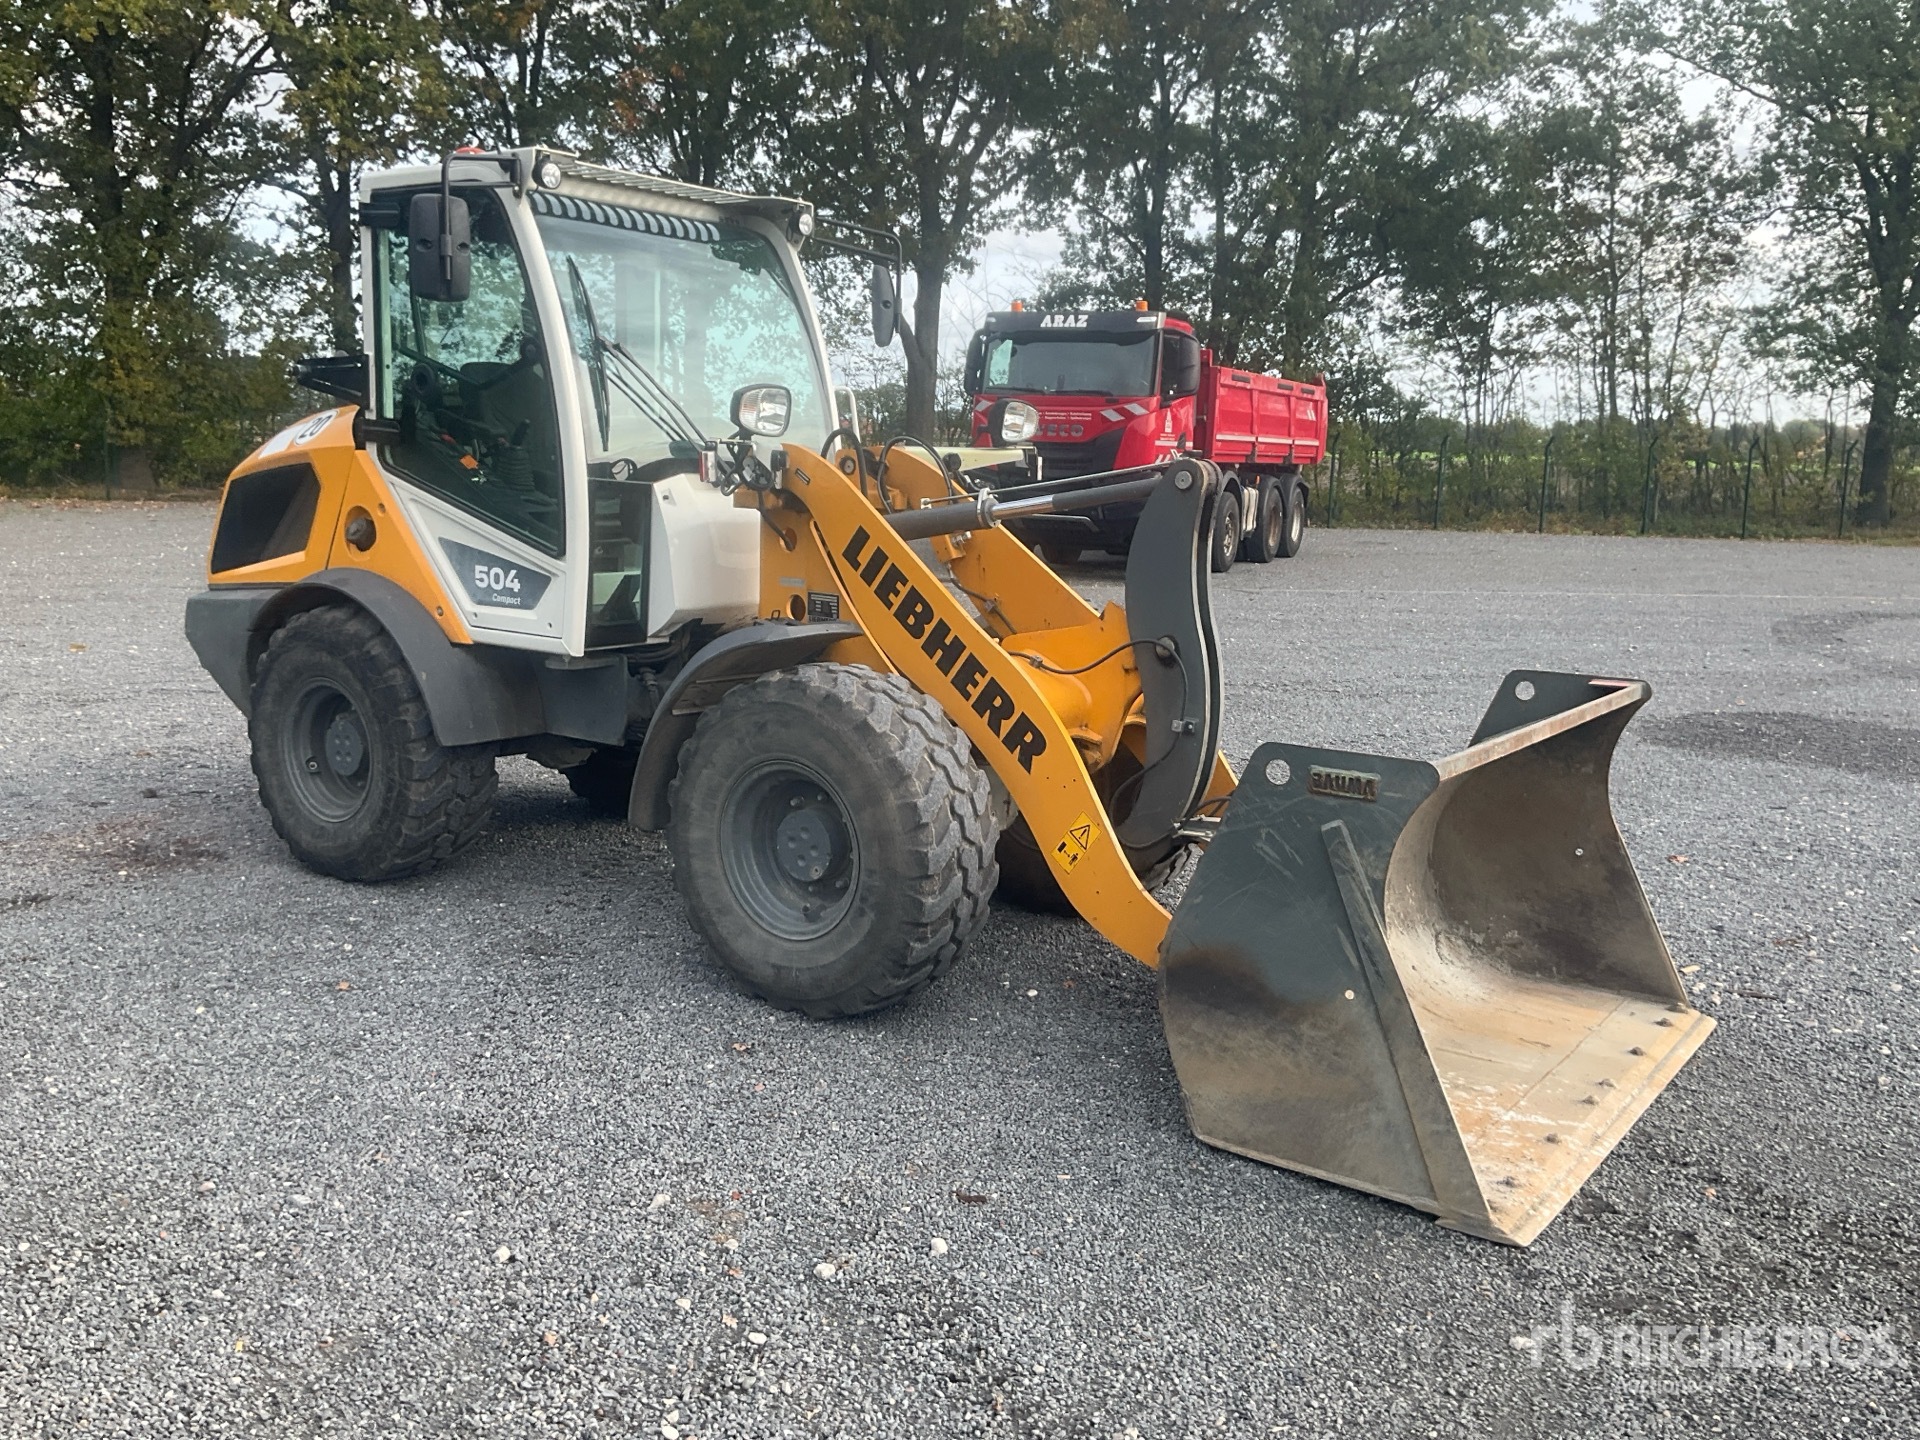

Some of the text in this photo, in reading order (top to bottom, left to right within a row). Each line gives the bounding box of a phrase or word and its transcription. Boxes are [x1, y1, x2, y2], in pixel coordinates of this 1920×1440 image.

[1040, 314, 1089, 328] ARAZ
[298, 414, 333, 440] 20
[474, 564, 521, 592] 504
[491, 593, 521, 605] Compact
[842, 525, 1047, 774] LIEBHERR
[1311, 771, 1378, 798] BAUMA
